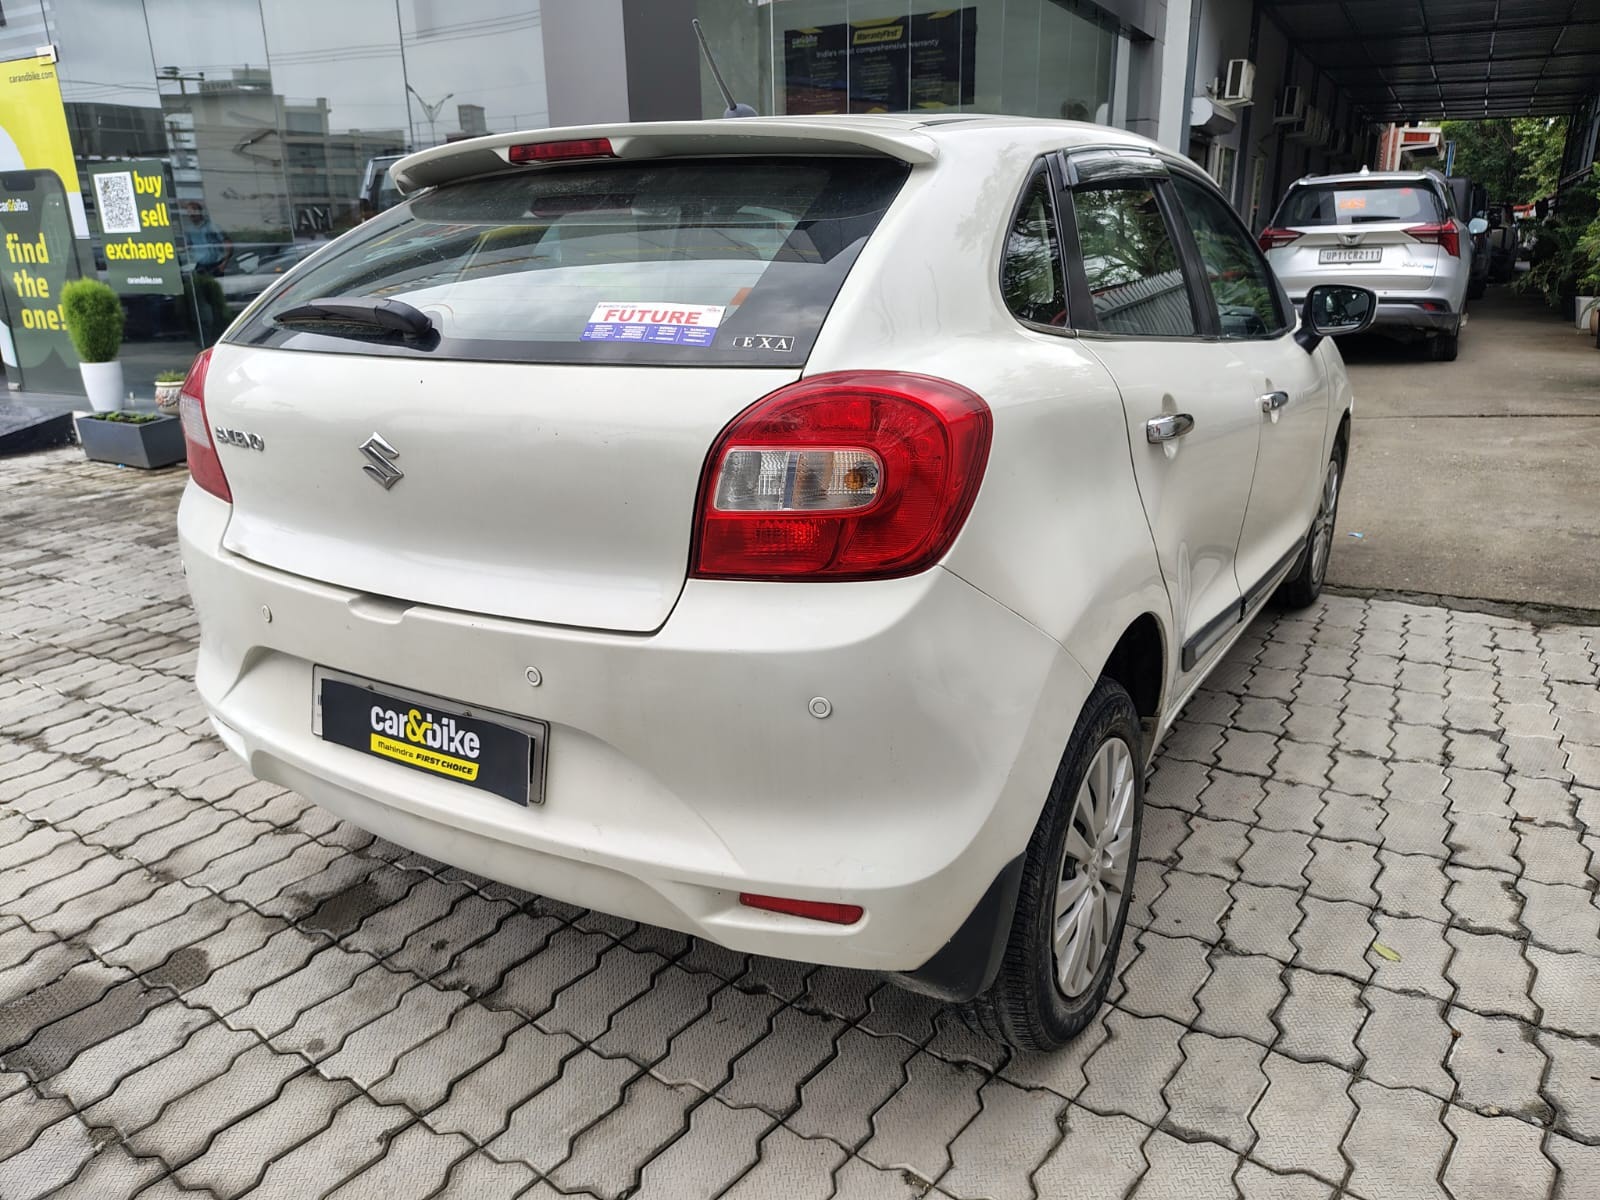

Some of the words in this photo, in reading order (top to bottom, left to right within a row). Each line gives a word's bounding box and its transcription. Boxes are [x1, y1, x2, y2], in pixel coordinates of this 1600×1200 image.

[838, 47, 855, 56] mst
[856, 42, 907, 54] comprehensive
[9, 71, 54, 83] carandbike.com
[133, 170, 162, 198] buy
[141, 202, 170, 227] sell
[6, 232, 49, 264] find
[105, 237, 175, 264] exchange
[1326, 250, 1380, 260] UP11CR2111
[13, 269, 49, 299] the
[21, 304, 68, 331] one!
[603, 309, 702, 325] FUTURE
[371, 705, 480, 758] car&bike
[378, 741, 414, 758] Mahindra
[416, 753, 441, 766] FIRST
[441, 760, 474, 775] CHOICE
